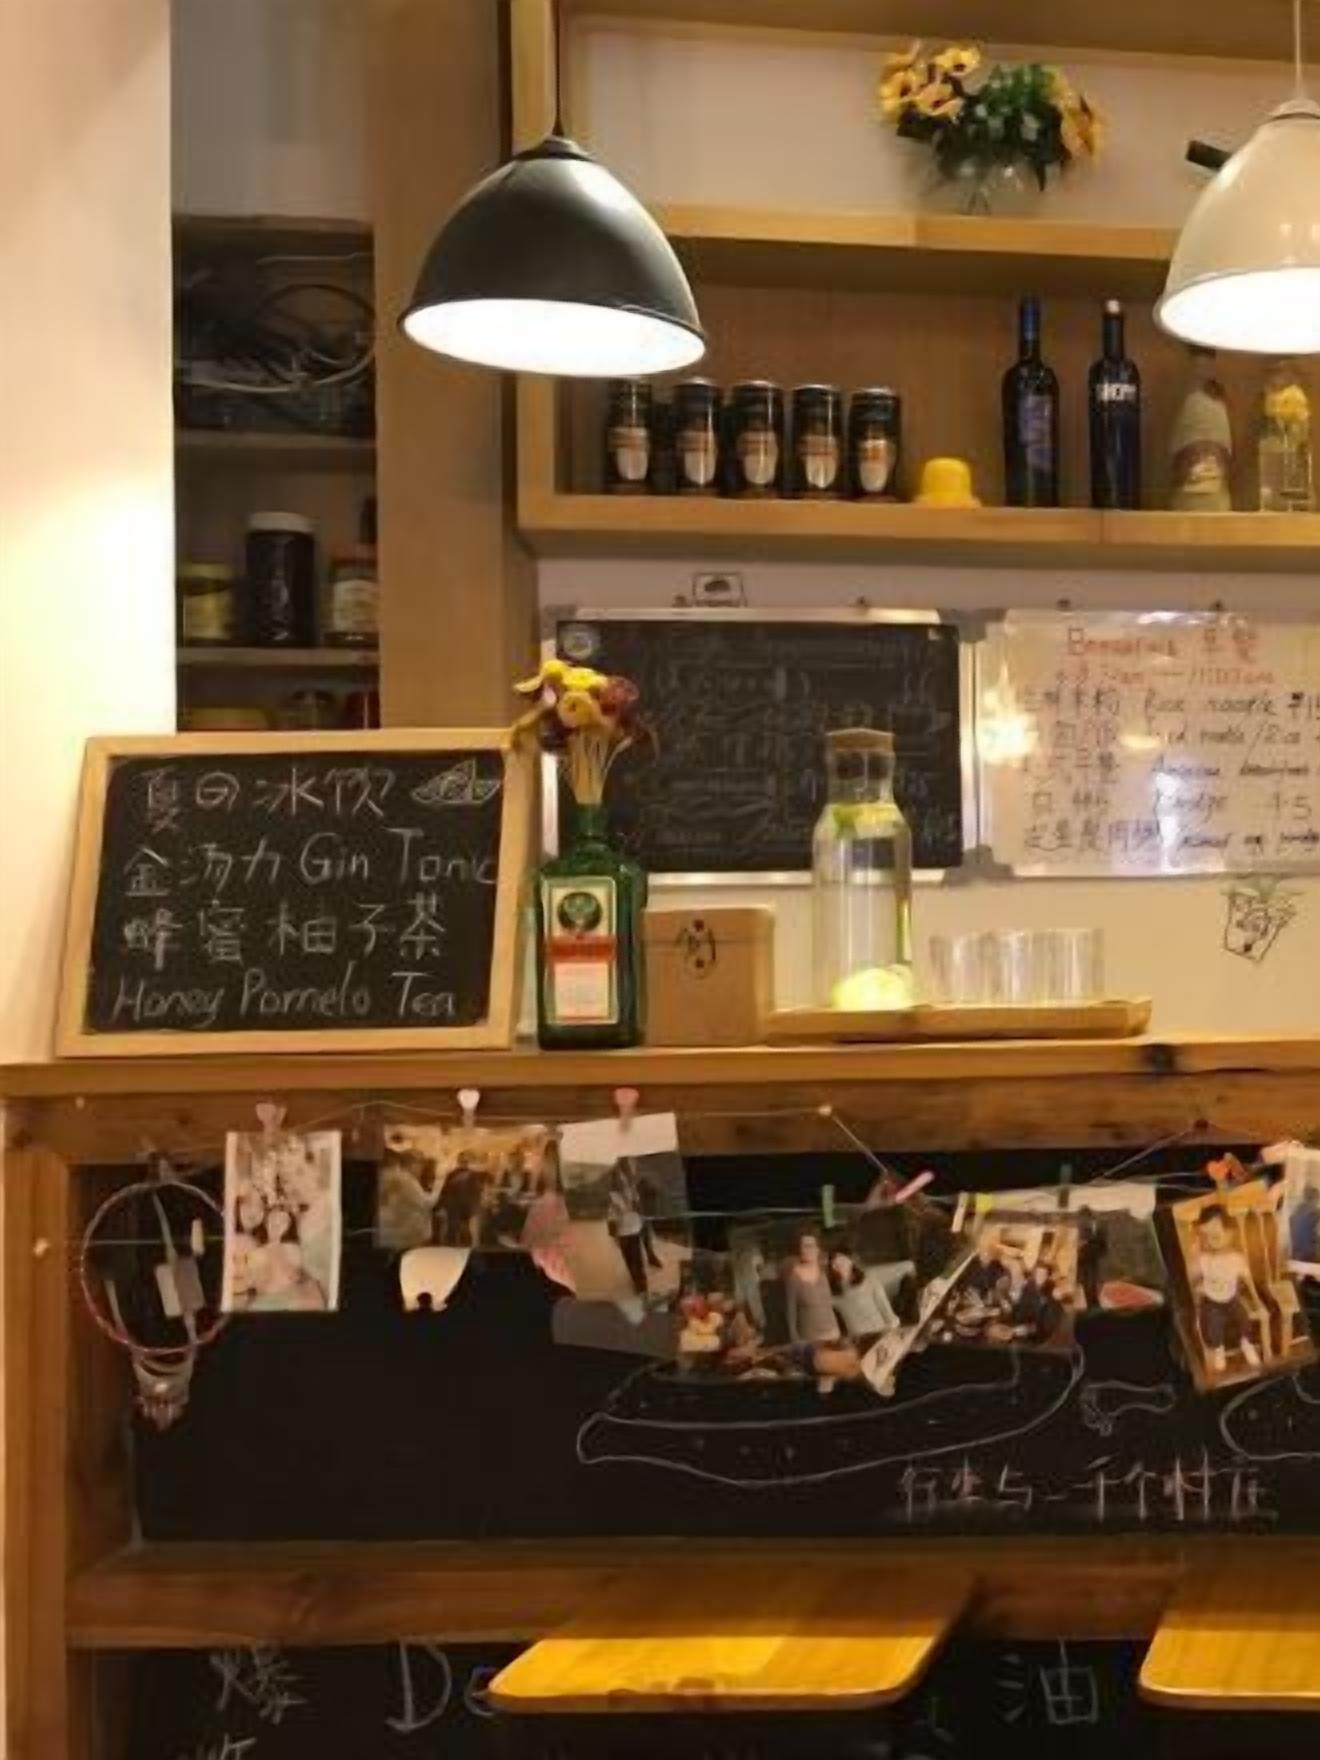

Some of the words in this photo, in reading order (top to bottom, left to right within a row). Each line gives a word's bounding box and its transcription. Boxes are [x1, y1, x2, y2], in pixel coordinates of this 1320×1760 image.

[299, 831, 370, 886] Gin
[122, 892, 447, 971] 蜂蜜柚子茶
[110, 973, 226, 1028] Honey
[239, 960, 372, 1017] Pomelo
